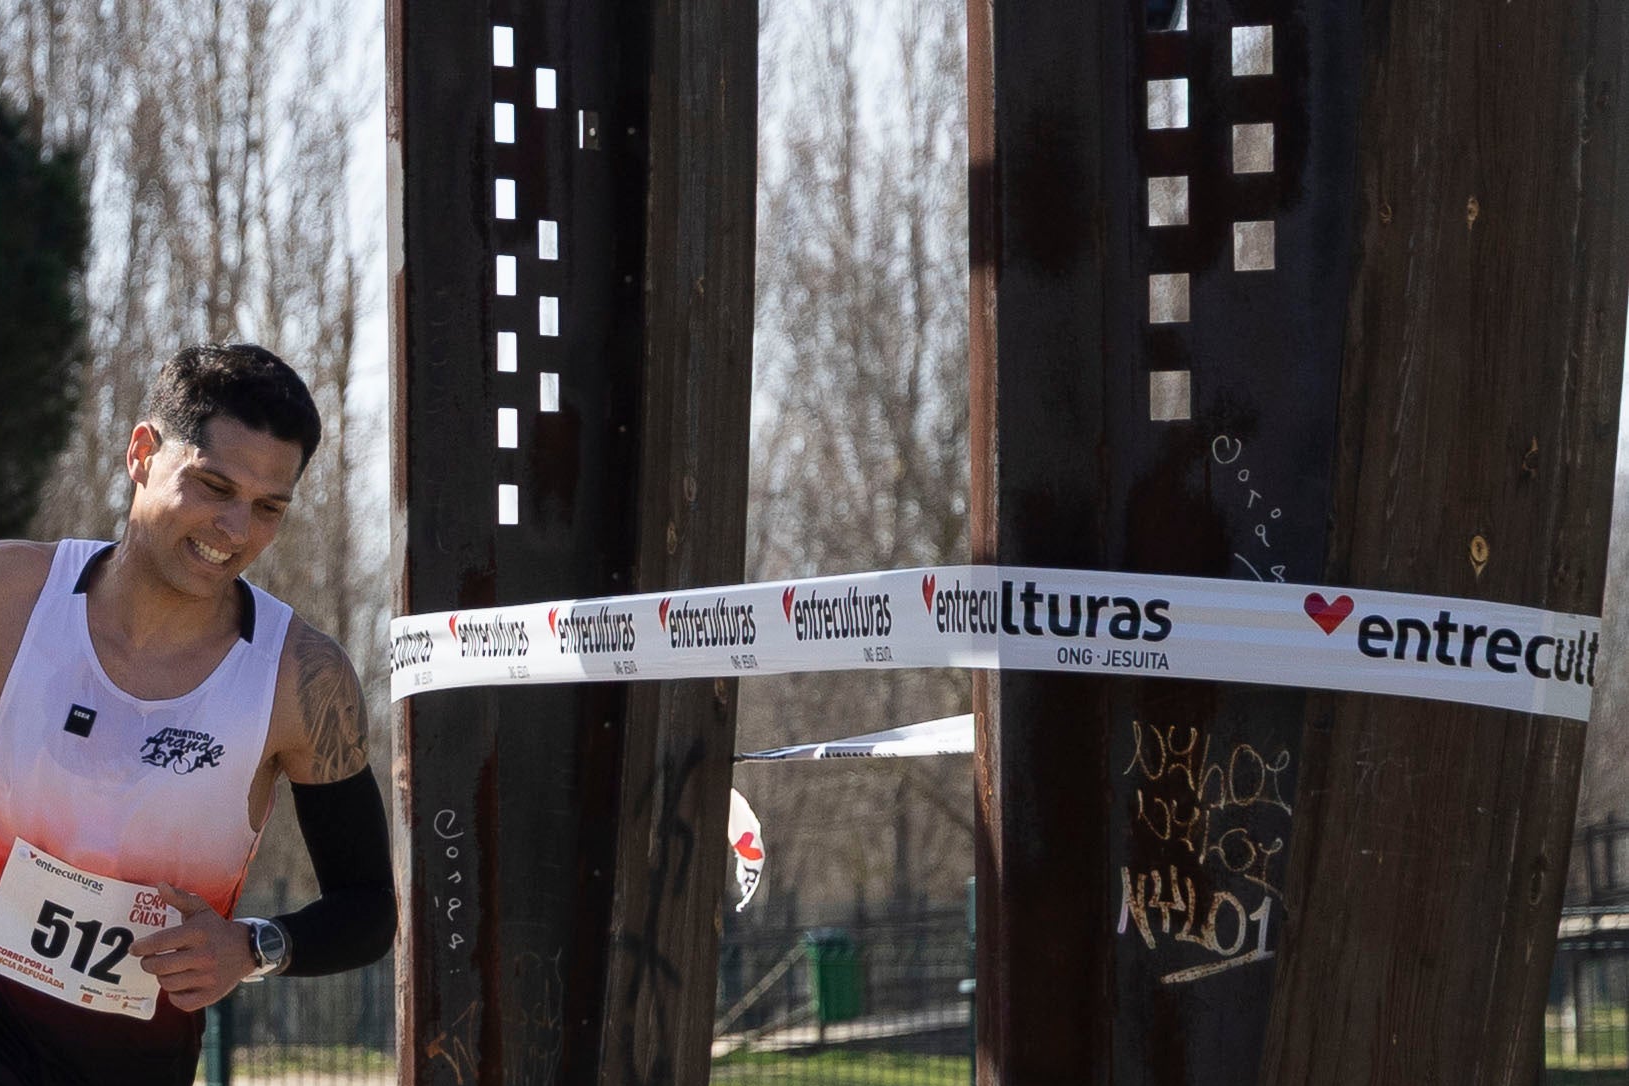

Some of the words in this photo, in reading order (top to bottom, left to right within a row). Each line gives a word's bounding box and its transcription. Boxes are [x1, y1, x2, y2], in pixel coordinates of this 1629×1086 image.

[558, 606, 635, 654] entreculturas
[669, 598, 756, 648] entreculturas
[794, 586, 891, 641] entreculturas
[936, 580, 1172, 642] entreculturas
[1057, 647, 1092, 665] ONG
[1102, 649, 1170, 670] JESUITA
[35, 857, 104, 892] entreculturas
[129, 909, 167, 928] CAUSA
[31, 900, 134, 984] 512
[17, 964, 65, 990] REFUGIADA
[24, 957, 42, 970] POR
[43, 964, 54, 976] LA
